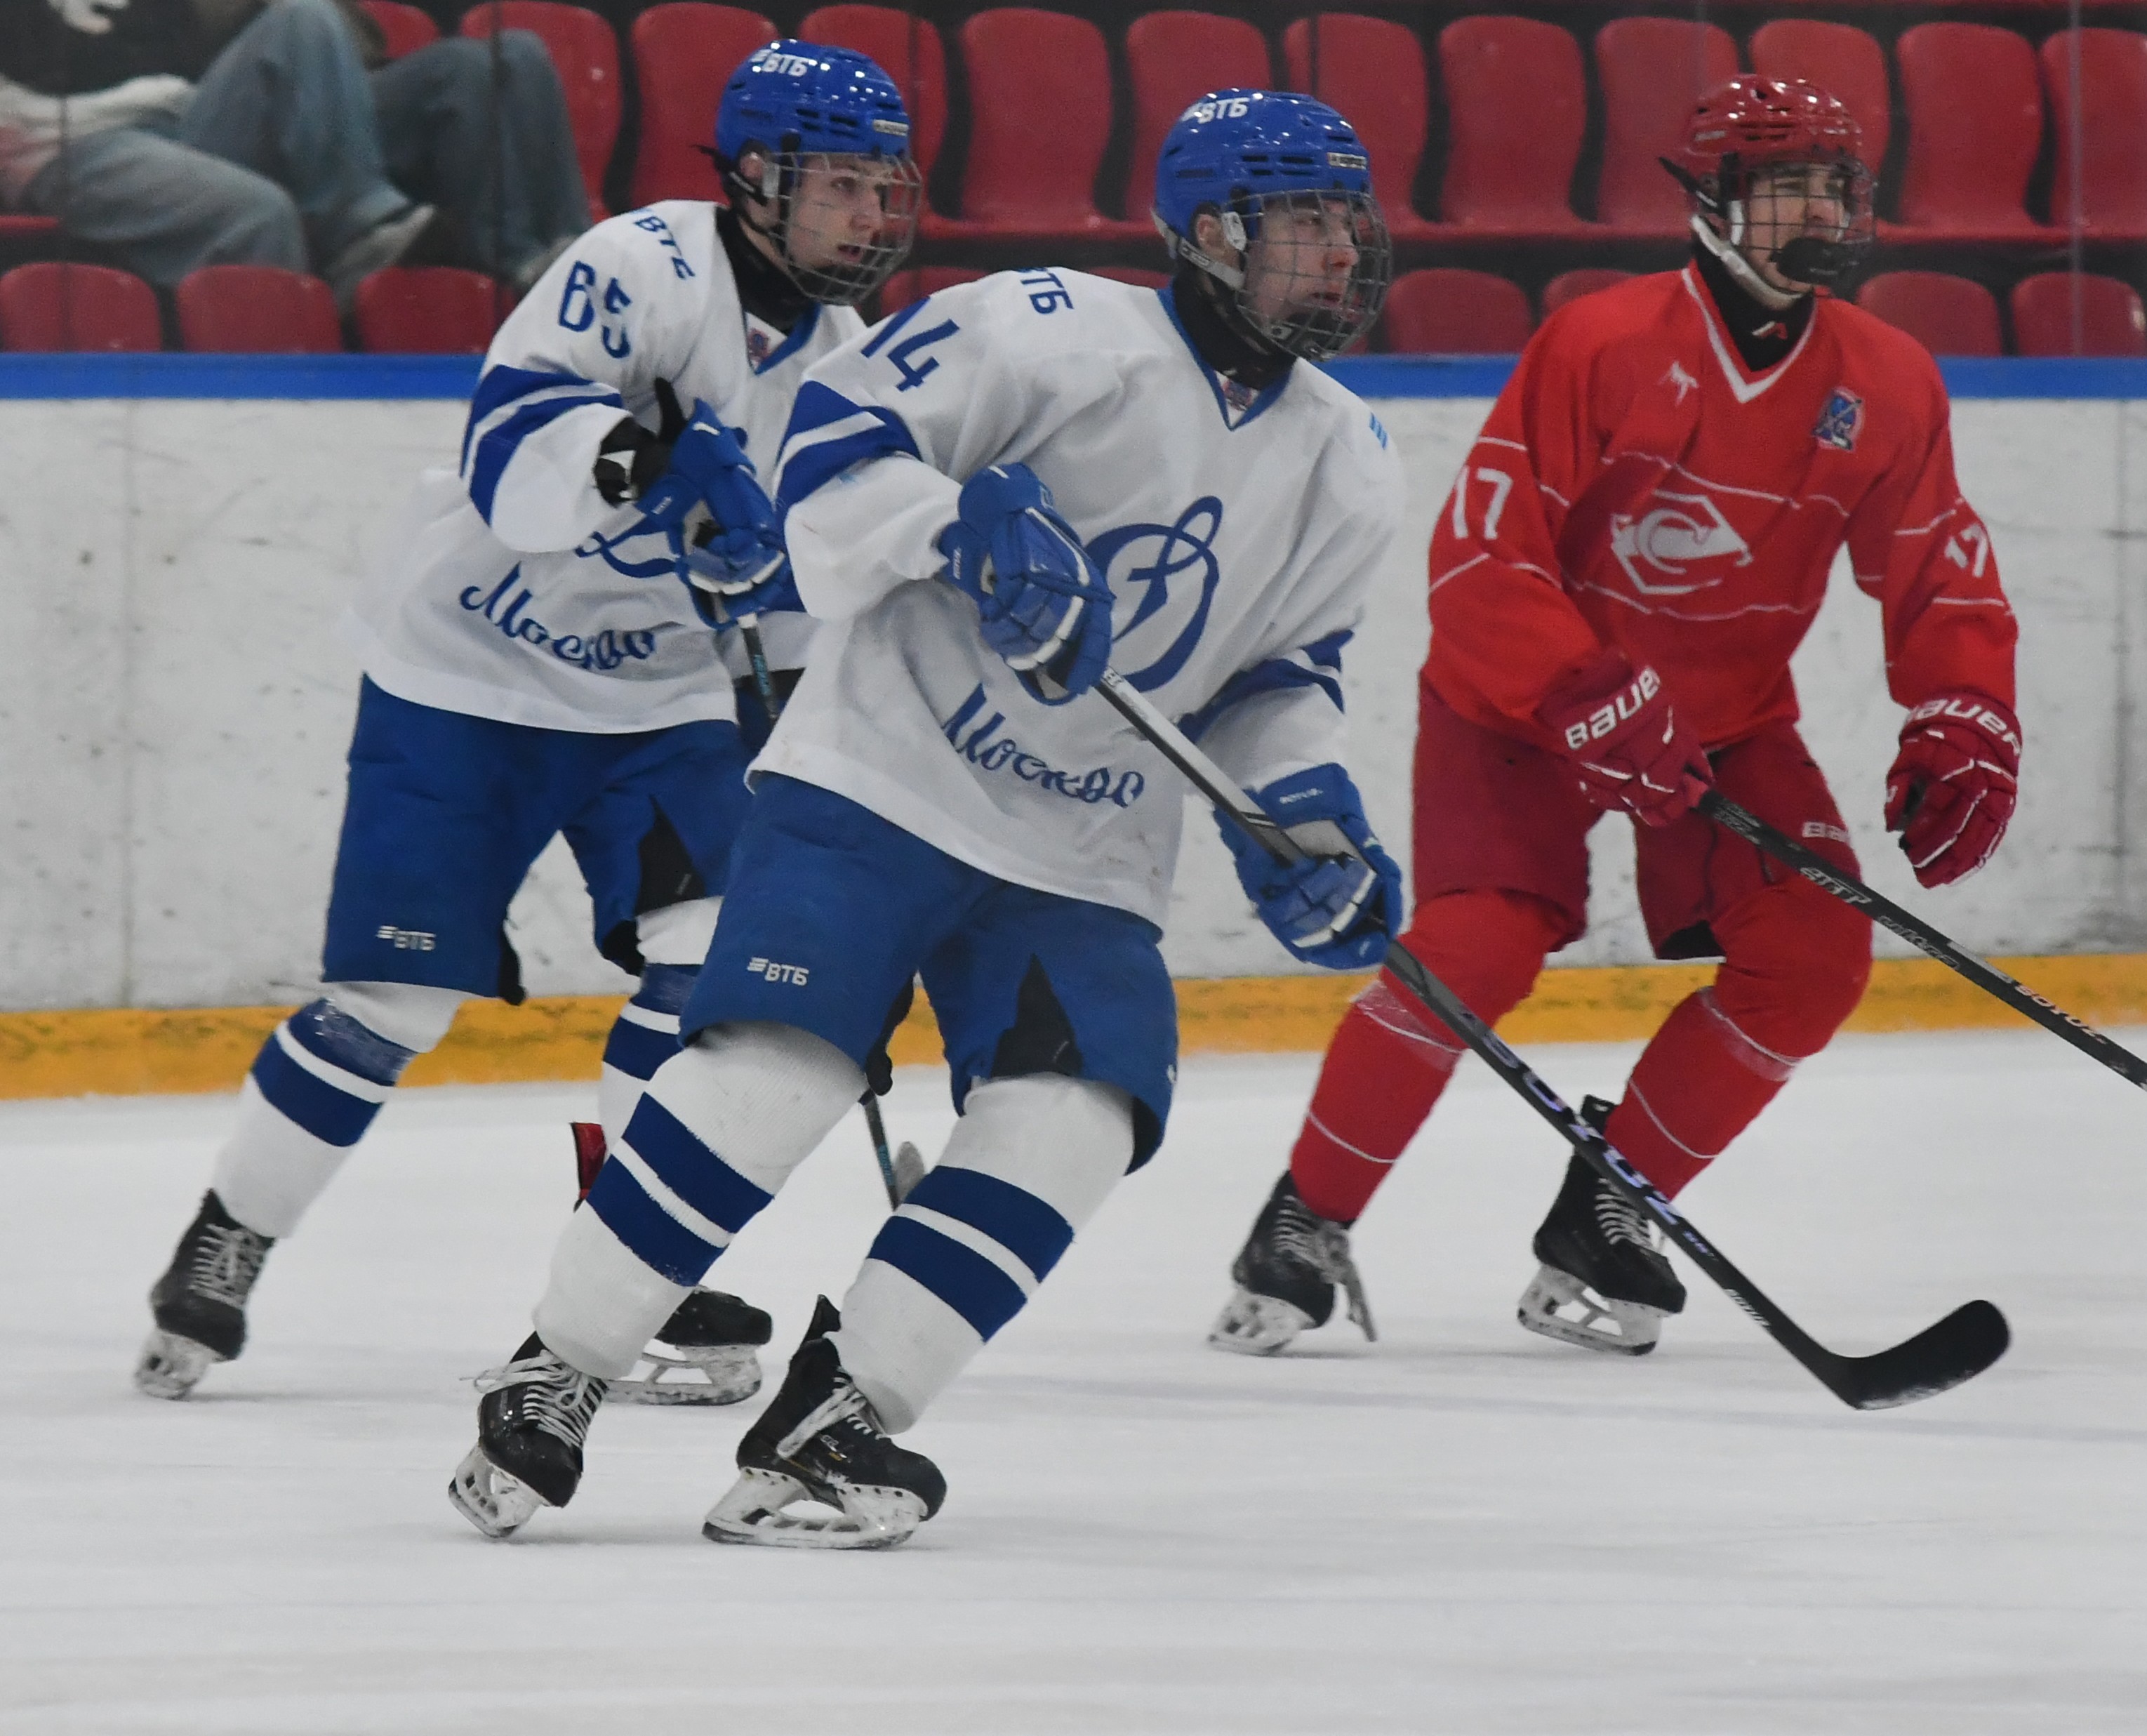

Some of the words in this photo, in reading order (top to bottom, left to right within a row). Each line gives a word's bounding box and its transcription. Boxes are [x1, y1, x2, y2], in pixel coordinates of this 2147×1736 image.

[559, 260, 632, 359] 65
[860, 296, 960, 392] 14
[1451, 464, 1514, 540] 17
[1943, 522, 1989, 578] 17
[394, 930, 436, 950] ВТБ
[764, 962, 809, 986] ВТБ
